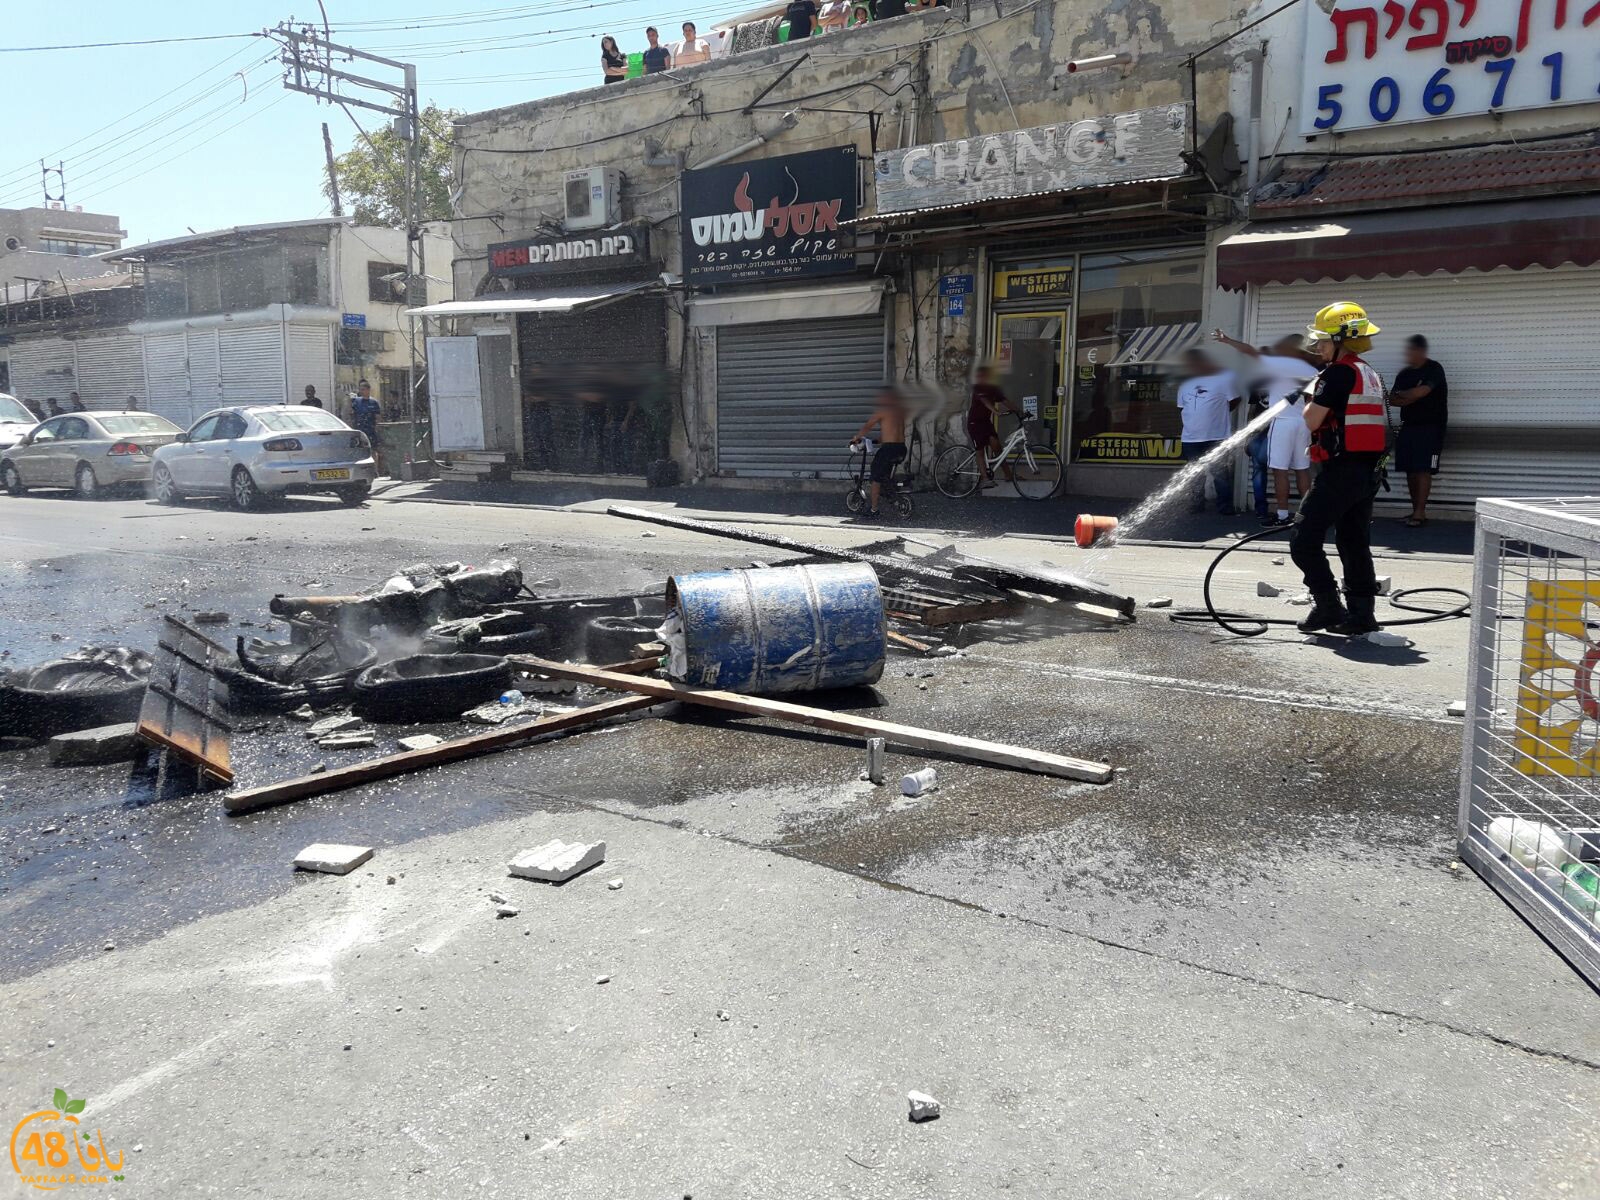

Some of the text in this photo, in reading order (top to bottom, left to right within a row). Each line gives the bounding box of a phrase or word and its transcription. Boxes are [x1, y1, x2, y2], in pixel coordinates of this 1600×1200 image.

[1325, 0, 1477, 64] יפית
[1314, 52, 1600, 129] 50671
[903, 112, 1142, 188] CHANGE
[690, 208, 767, 246] עמוס
[529, 239, 598, 263] המותגים
[600, 235, 634, 256] בית
[698, 252, 728, 262] בשר
[1010, 273, 1067, 287] WESTERN
[950, 299, 963, 311] 164
[1080, 439, 1139, 448] WESTERN
[1097, 448, 1139, 457] UNION
